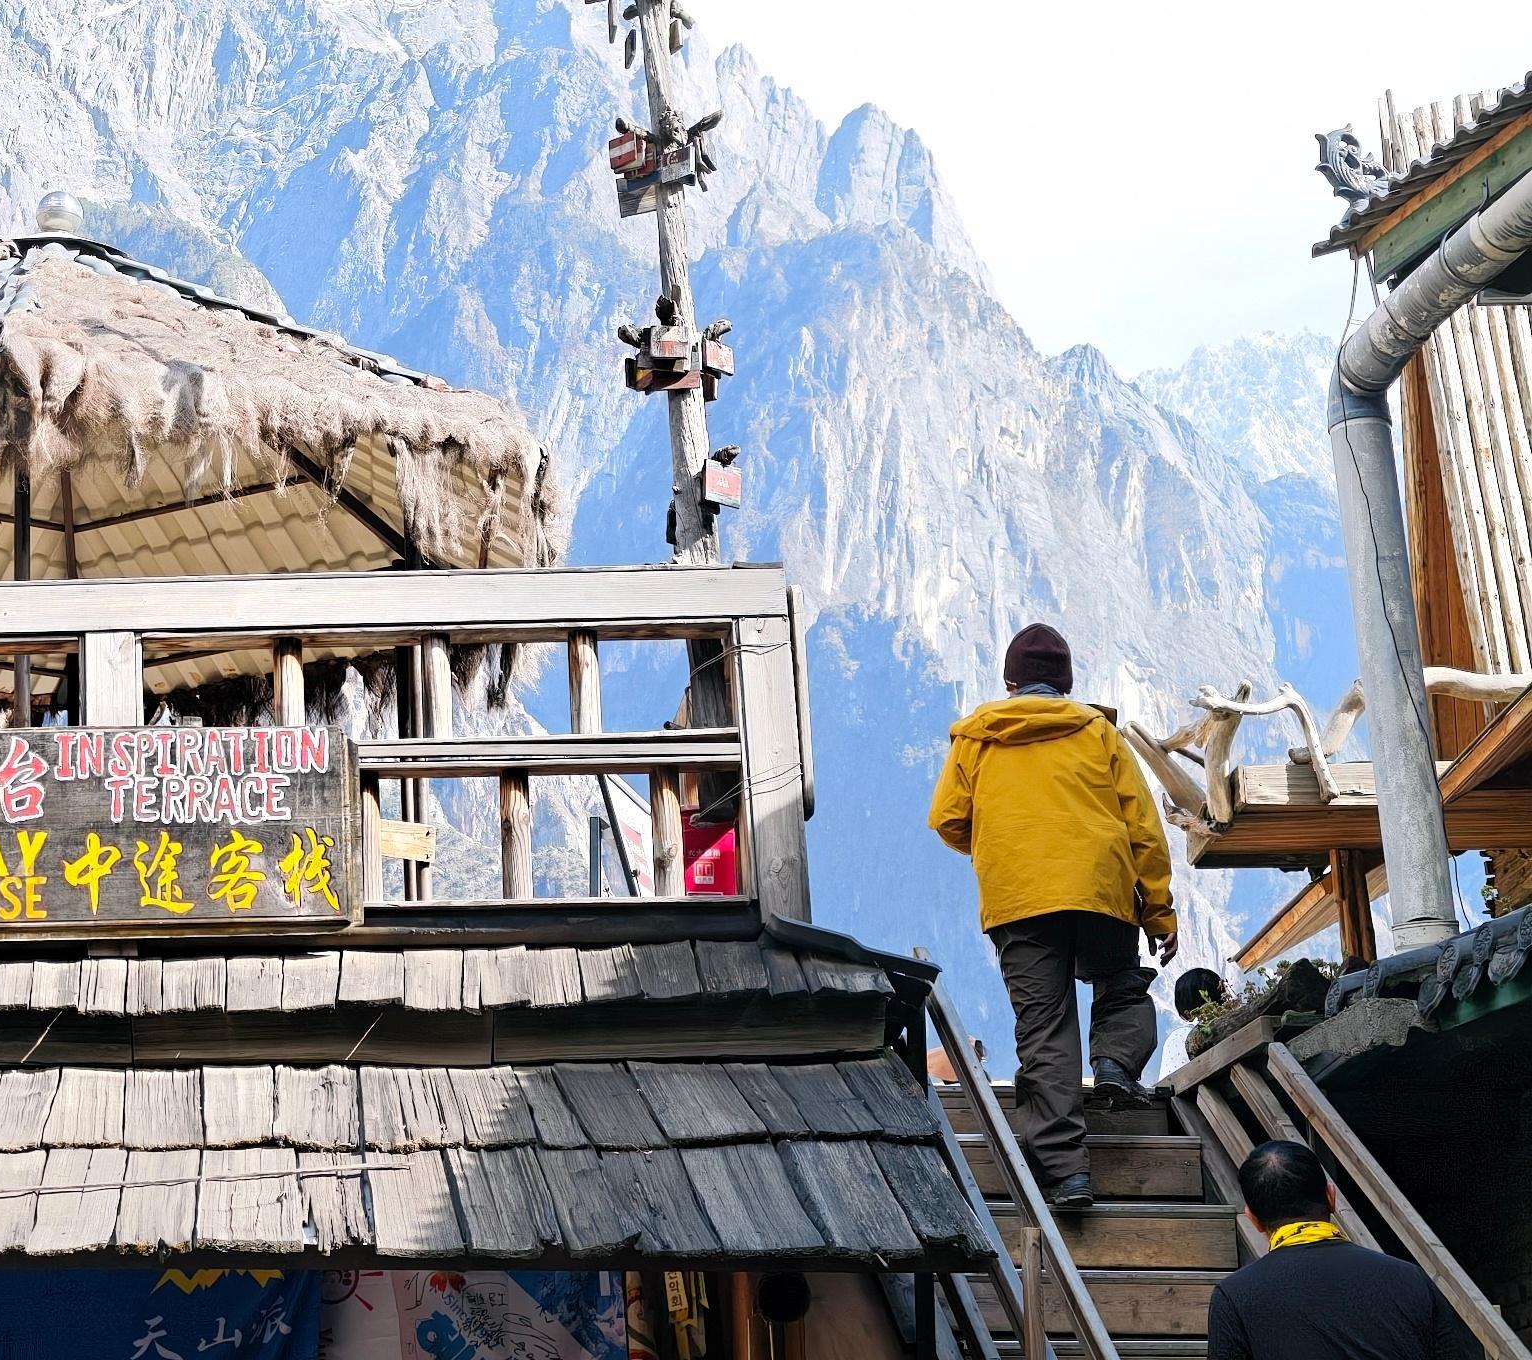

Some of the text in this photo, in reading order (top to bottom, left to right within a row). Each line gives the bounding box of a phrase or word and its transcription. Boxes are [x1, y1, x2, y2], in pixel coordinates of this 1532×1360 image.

[53, 727, 329, 781] INSPIRATION
[104, 773, 292, 824] TERRACE
[63, 830, 340, 915] 中途客栈
